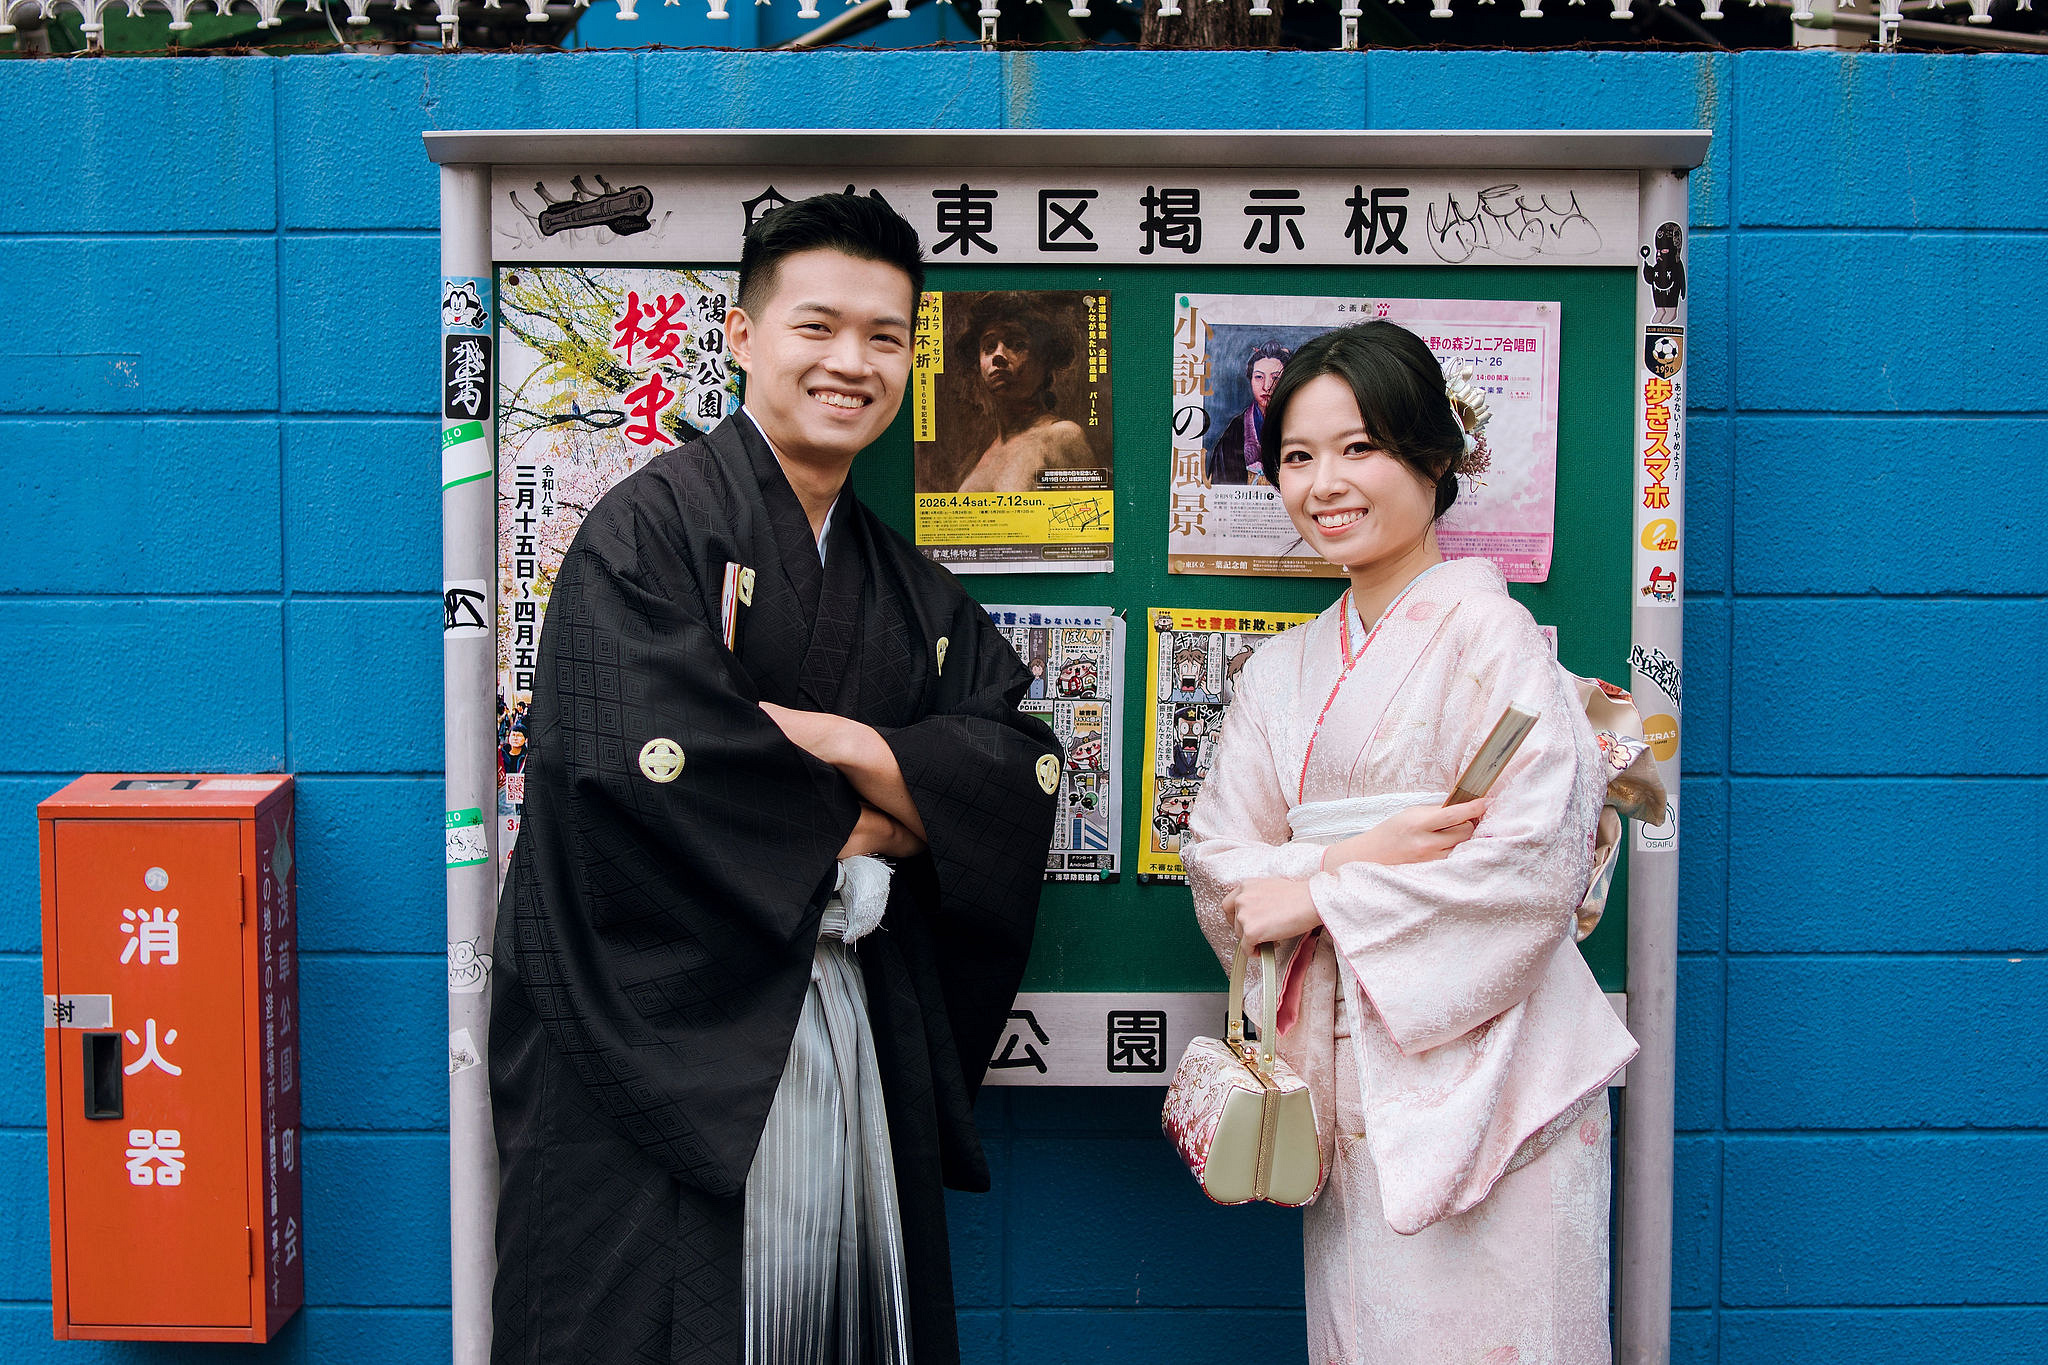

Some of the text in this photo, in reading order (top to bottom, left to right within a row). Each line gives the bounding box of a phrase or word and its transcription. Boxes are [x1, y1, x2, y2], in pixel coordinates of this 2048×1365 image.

[843, 184, 1409, 256] 東区掲示板
[697, 294, 727, 420] 隅田公園
[916, 298, 931, 369] 中村不折
[932, 297, 940, 364] ナカムラ フセツ
[612, 291, 688, 447] 桜ま
[1655, 365, 1674, 373] 1996
[1169, 306, 1214, 536] 小説の風景
[1643, 377, 1673, 510] 歩きスマホ
[541, 464, 554, 518] 令和八年
[932, 548, 978, 559] 書道博物館
[1656, 538, 1678, 551] ゼロ
[989, 612, 1102, 626] 被害に遭わないために
[1181, 617, 1305, 632] ニセ警察詐欺に要注
[1149, 863, 1187, 872] 不審な電
[1645, 841, 1674, 849] OSAIFU
[120, 907, 186, 1186] 消火器
